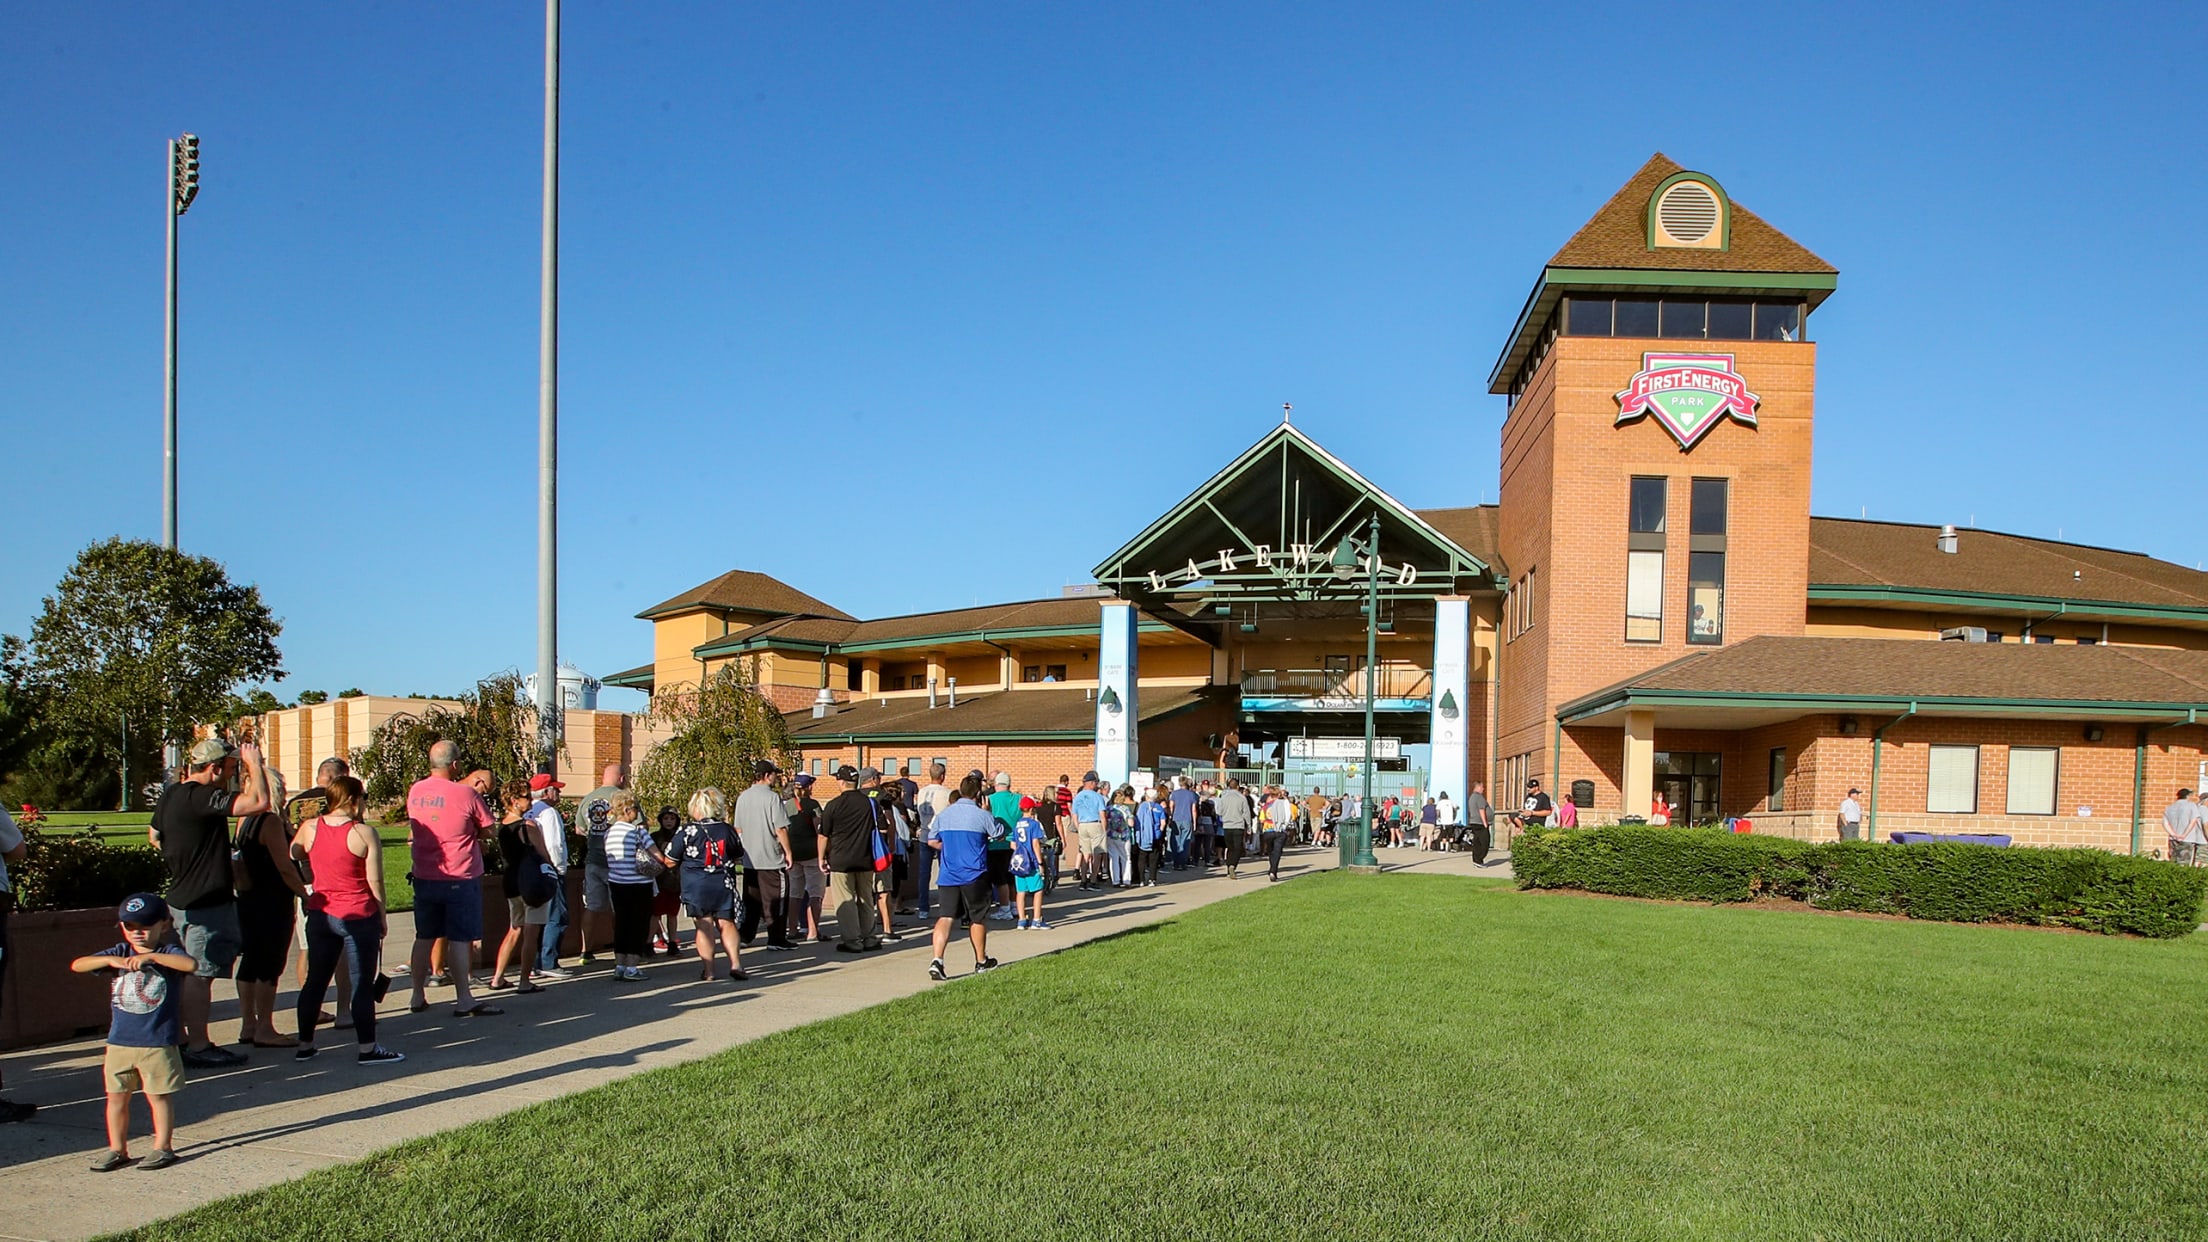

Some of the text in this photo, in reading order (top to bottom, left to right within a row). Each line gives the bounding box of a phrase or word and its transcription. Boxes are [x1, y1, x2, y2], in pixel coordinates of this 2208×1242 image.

[1638, 369, 1740, 397] FIRSTENERGY
[1671, 396, 1705, 406] PARK
[1147, 543, 1417, 593] LAKEWOD
[1017, 827, 1027, 843] 3
